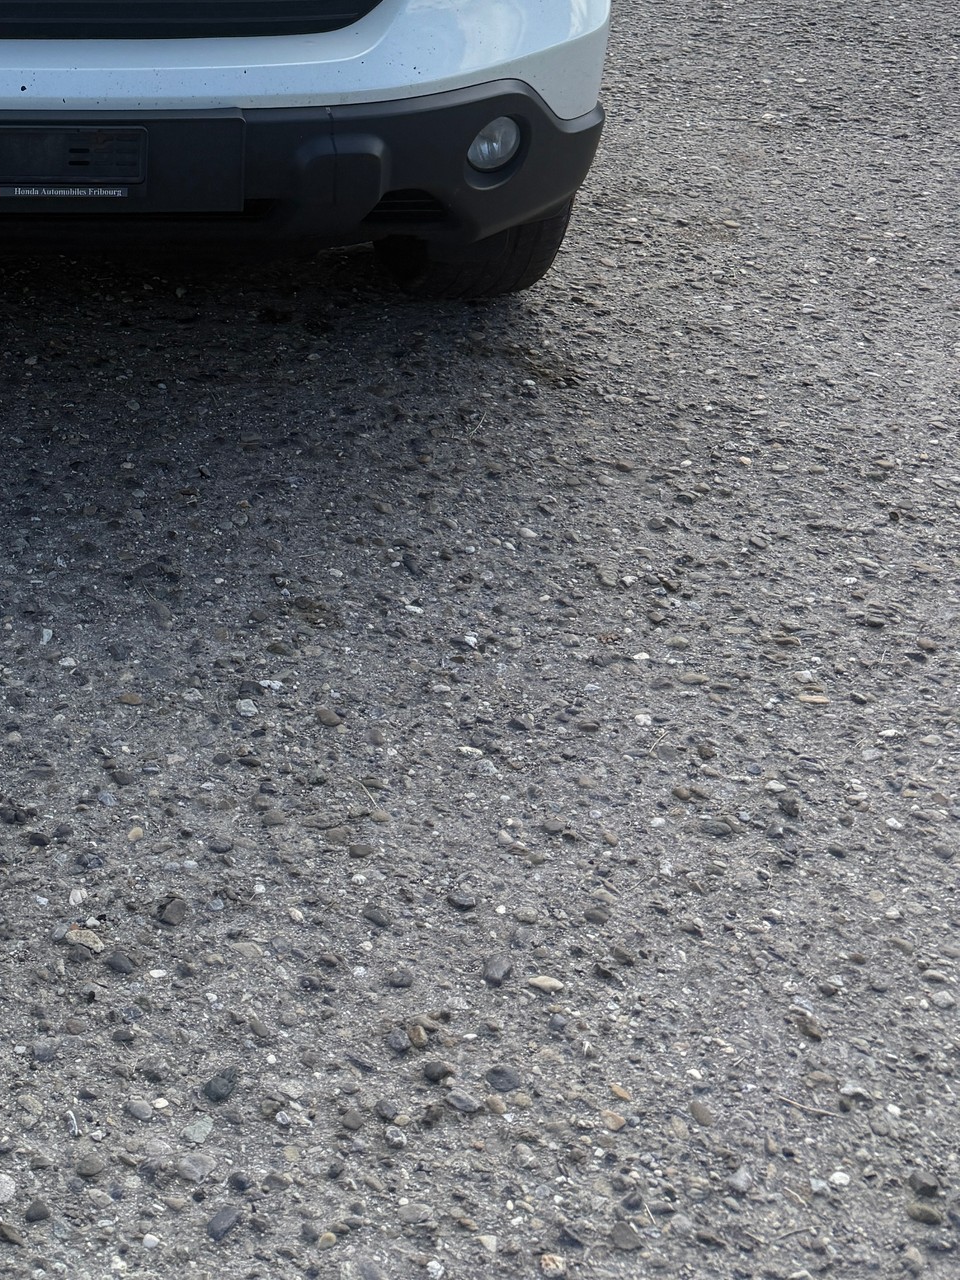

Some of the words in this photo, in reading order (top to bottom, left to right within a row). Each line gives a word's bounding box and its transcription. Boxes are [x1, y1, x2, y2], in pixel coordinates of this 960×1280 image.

[14, 187, 39, 195] Honda
[41, 187, 87, 196] Automobiles
[88, 188, 122, 197] Fribourg
